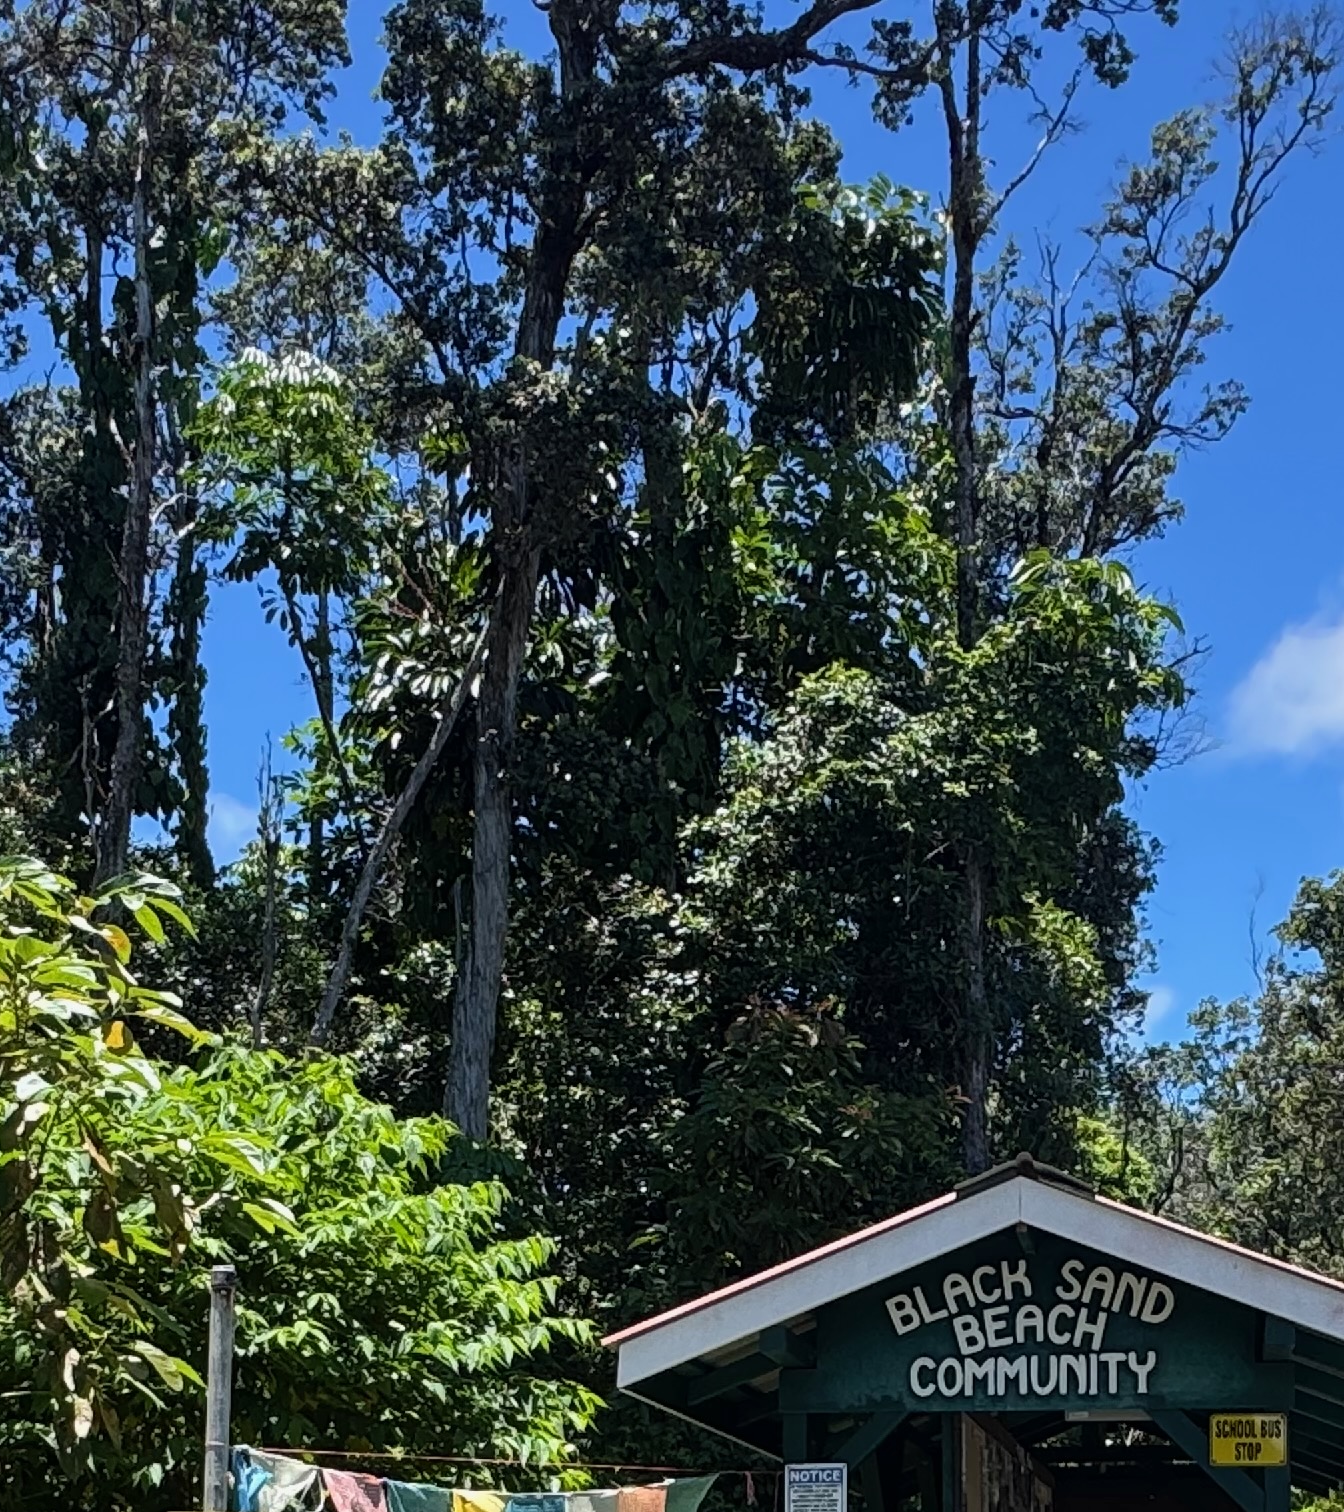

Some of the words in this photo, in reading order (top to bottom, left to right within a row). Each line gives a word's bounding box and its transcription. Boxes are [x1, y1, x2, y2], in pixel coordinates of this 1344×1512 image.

[885, 1259, 1032, 1336] BLACK
[1056, 1259, 1175, 1324] SAND
[952, 1304, 1107, 1356] BEACH
[910, 1350, 1156, 1398] COMMUNITY
[1215, 1419, 1257, 1439] SCHOOL
[1260, 1419, 1282, 1439] BUS
[1234, 1442, 1262, 1461] STOP
[790, 1470, 842, 1482] NOTICE
